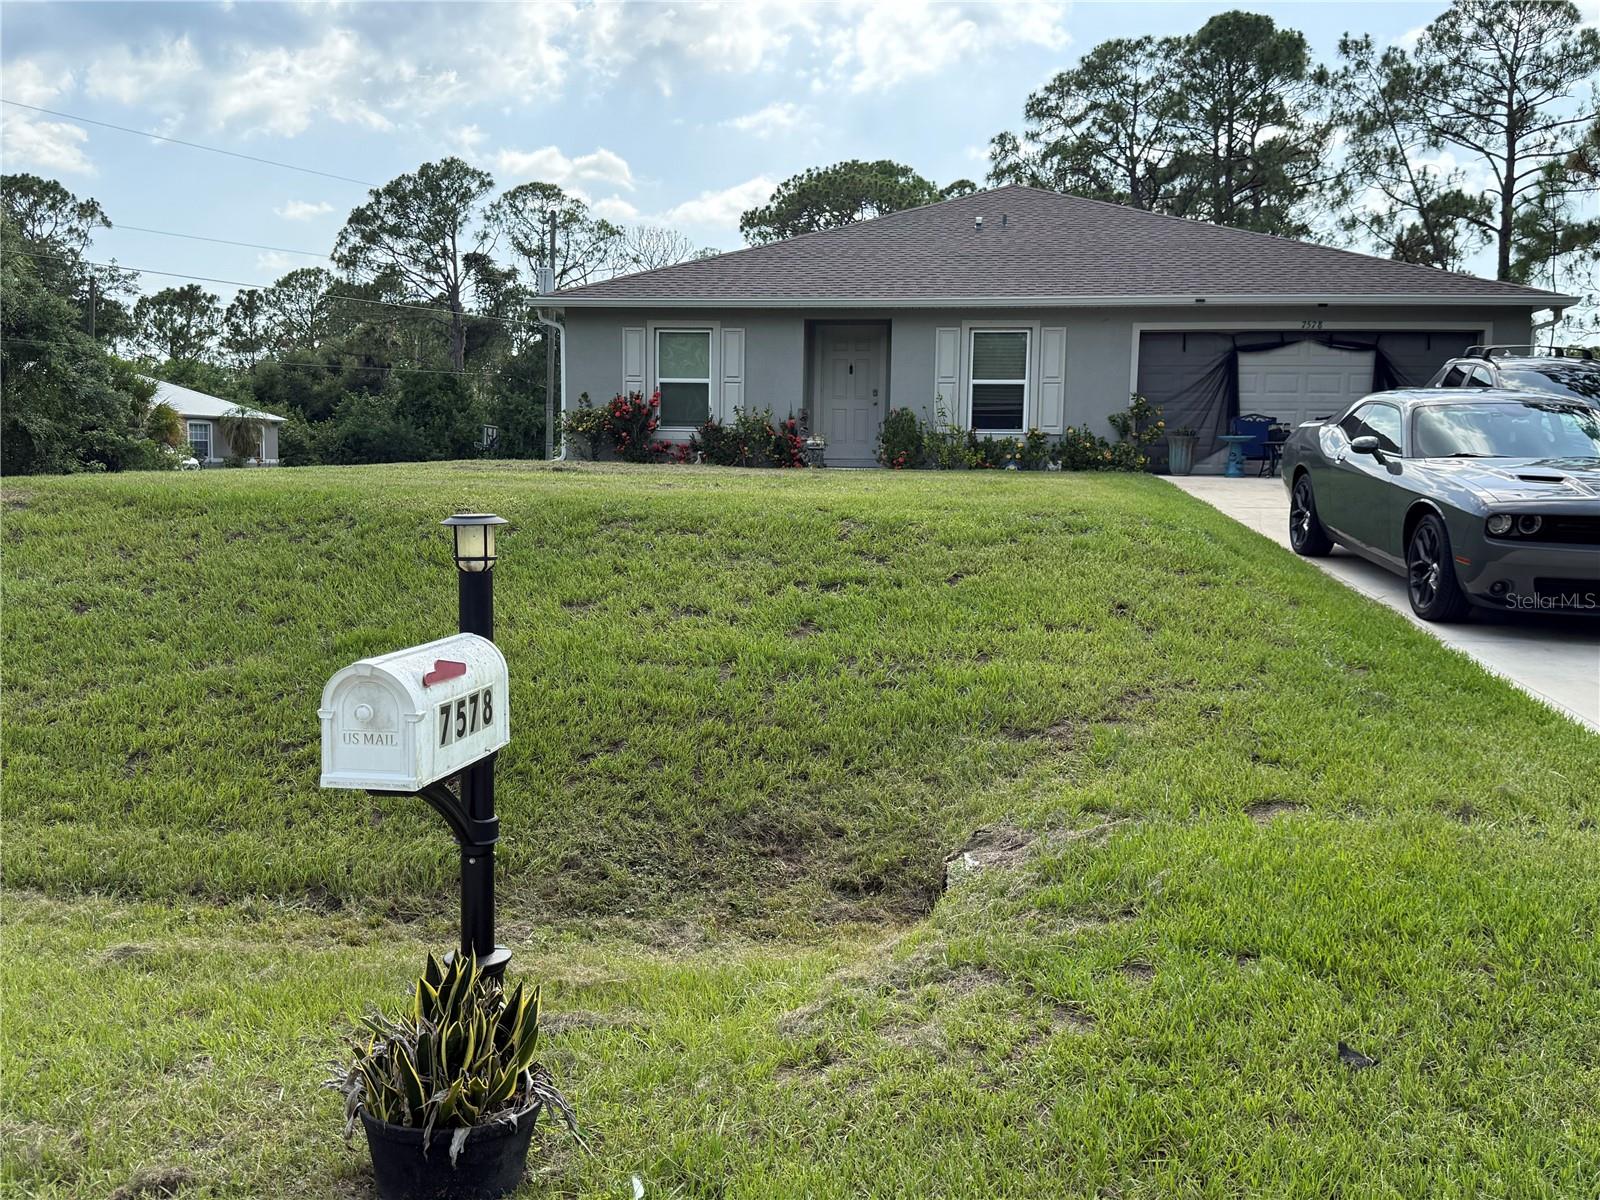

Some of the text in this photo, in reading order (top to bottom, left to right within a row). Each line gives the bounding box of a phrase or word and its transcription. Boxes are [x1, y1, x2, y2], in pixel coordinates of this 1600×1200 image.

[1302, 320, 1323, 329] 7578
[439, 689, 493, 746] 7578
[343, 732, 398, 746] US MAIL
